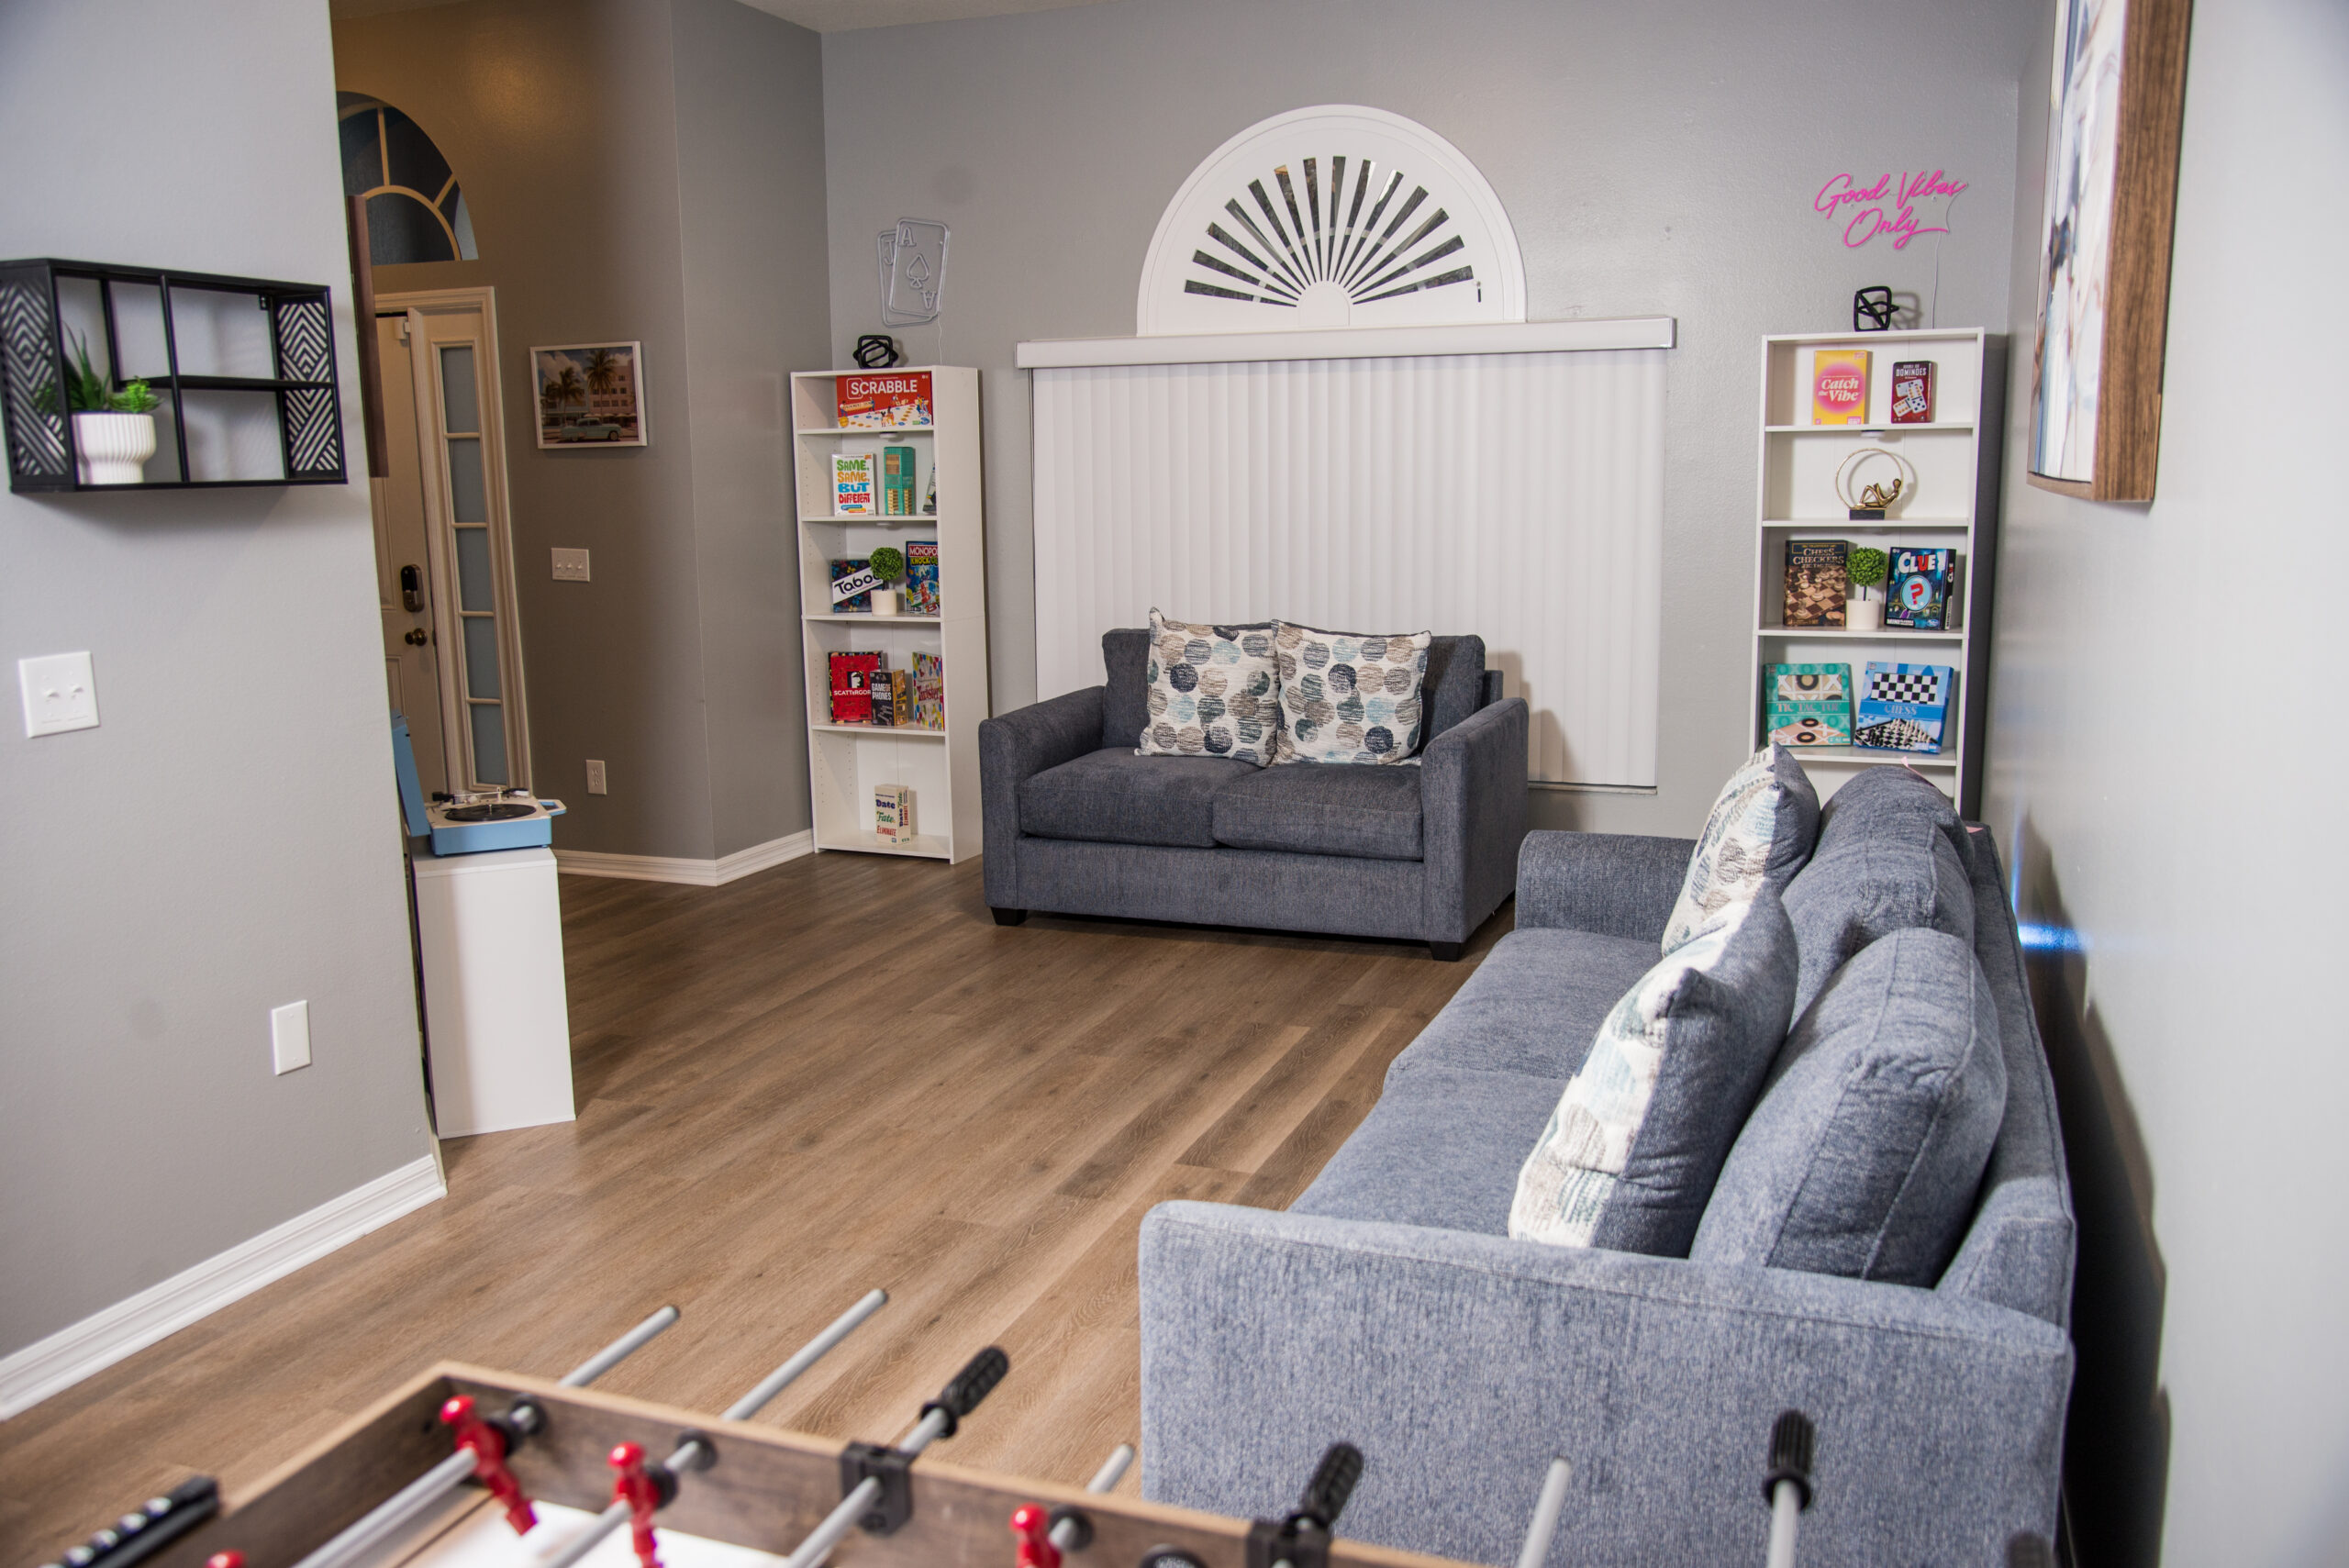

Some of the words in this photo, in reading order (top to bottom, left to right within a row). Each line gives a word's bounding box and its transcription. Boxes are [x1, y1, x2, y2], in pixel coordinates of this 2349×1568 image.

[1814, 172, 1890, 219] Good
[1896, 169, 1967, 209] Vibes
[1843, 206, 1949, 250] Only
[899, 228, 916, 247] A
[1896, 367, 1927, 377] DOMINOES
[851, 379, 918, 395] SCRABBLE
[1821, 377, 1859, 390] Catch
[1829, 389, 1859, 402] Vibe
[838, 482, 871, 494] BUT
[910, 556, 930, 565] KNOCK
[1792, 556, 1844, 565] CHECKERS
[1898, 551, 1936, 574] CLUE
[871, 683, 885, 692] GAME
[872, 692, 892, 701] PHONES
[1776, 703, 1794, 712] TIC
[1885, 705, 1917, 716] CHESS
[875, 799, 896, 809] Date
